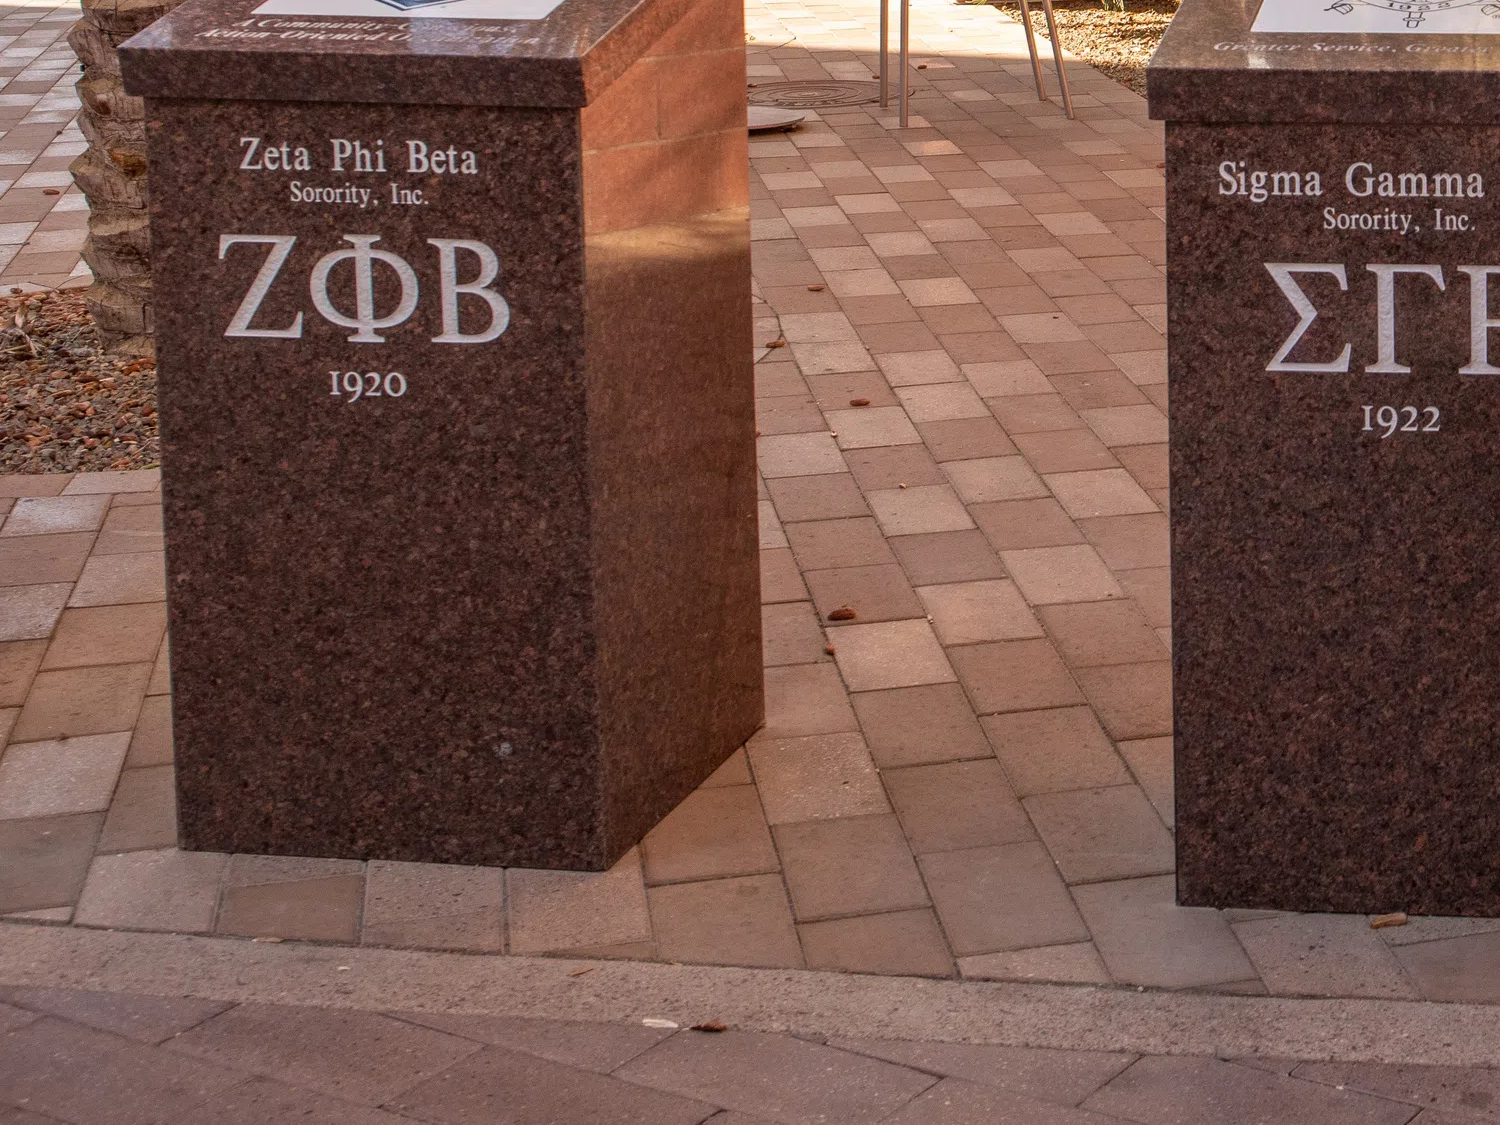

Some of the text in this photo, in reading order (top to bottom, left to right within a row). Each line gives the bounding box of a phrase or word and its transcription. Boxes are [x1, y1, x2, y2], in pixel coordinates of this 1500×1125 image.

[1387, 1, 1452, 12] 1922
[1213, 41, 1301, 52] Greater
[239, 137, 479, 175] Zeta Phi Beta
[289, 180, 430, 209] Sorority, Inc.
[1218, 161, 1323, 203] Sigma
[1345, 162, 1485, 198] Gamma
[1323, 206, 1477, 236] Sorority, Inc.
[218, 233, 511, 344] ΖΦΒ
[328, 370, 408, 404] 1920
[1361, 404, 1442, 440] 1922
